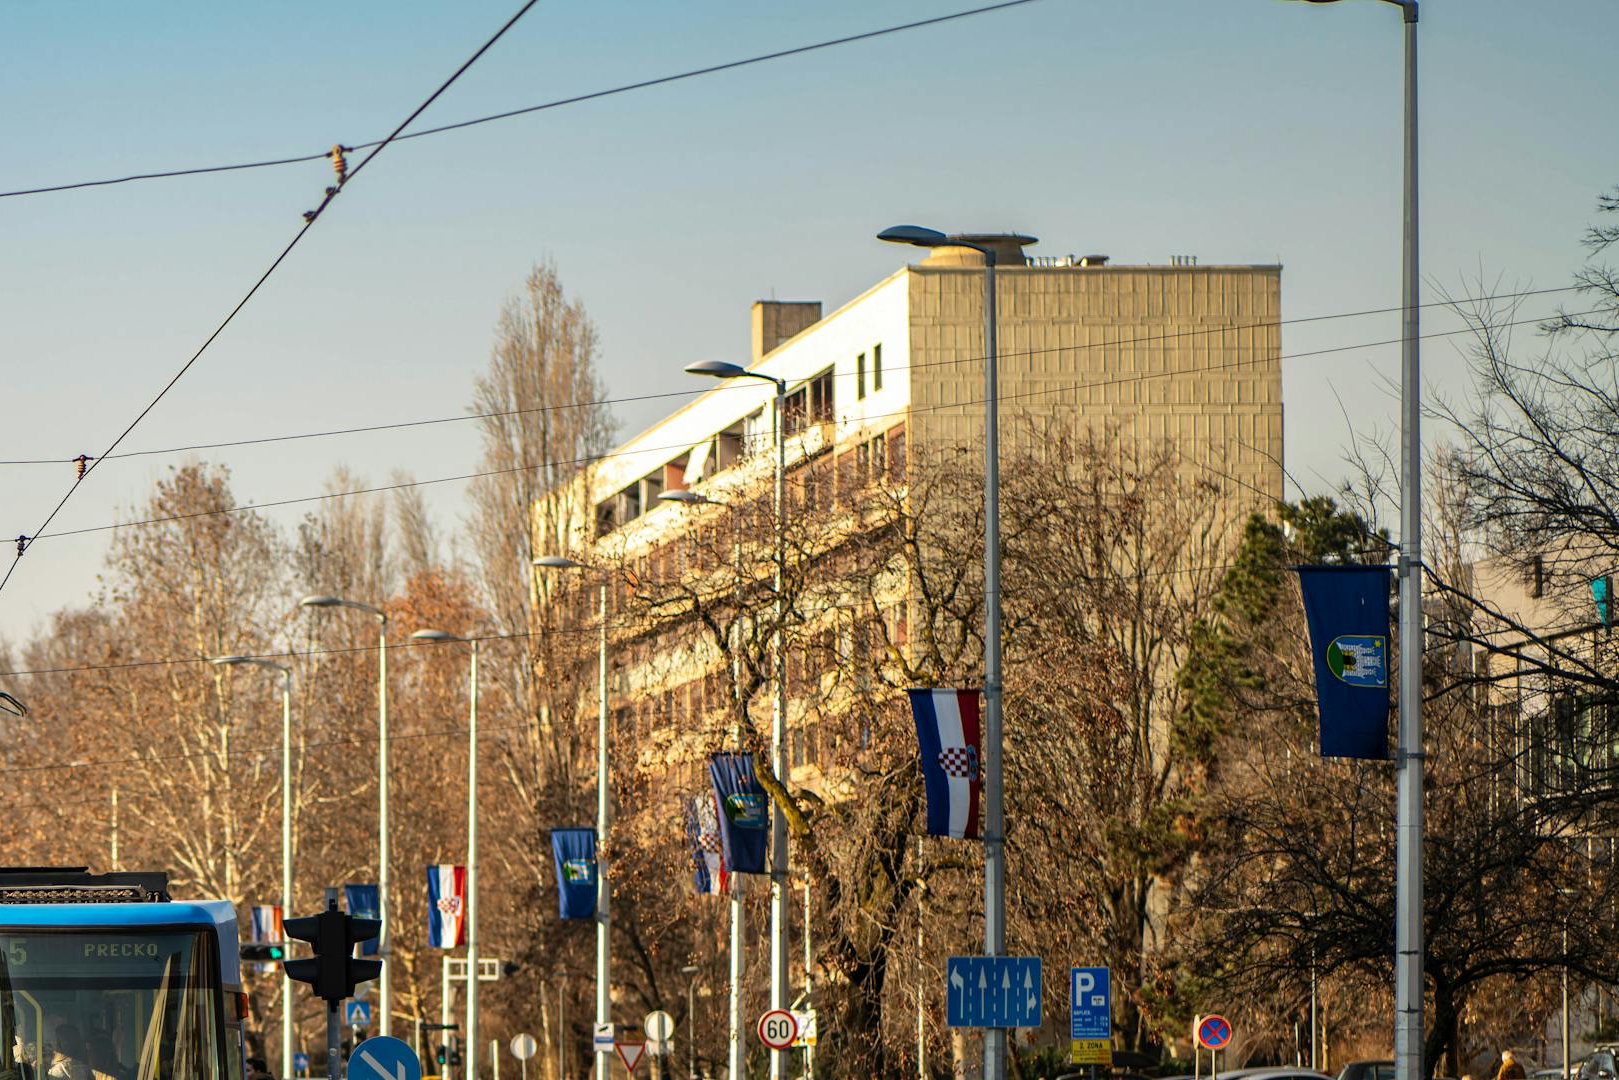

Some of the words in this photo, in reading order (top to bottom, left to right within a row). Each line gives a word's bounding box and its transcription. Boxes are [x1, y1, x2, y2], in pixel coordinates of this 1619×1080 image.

[9, 938, 27, 966] 5
[84, 943, 158, 957] PRECKO
[1076, 972, 1095, 1006] P
[767, 1020, 789, 1039] 60
[1087, 1041, 1103, 1049] ZONA
